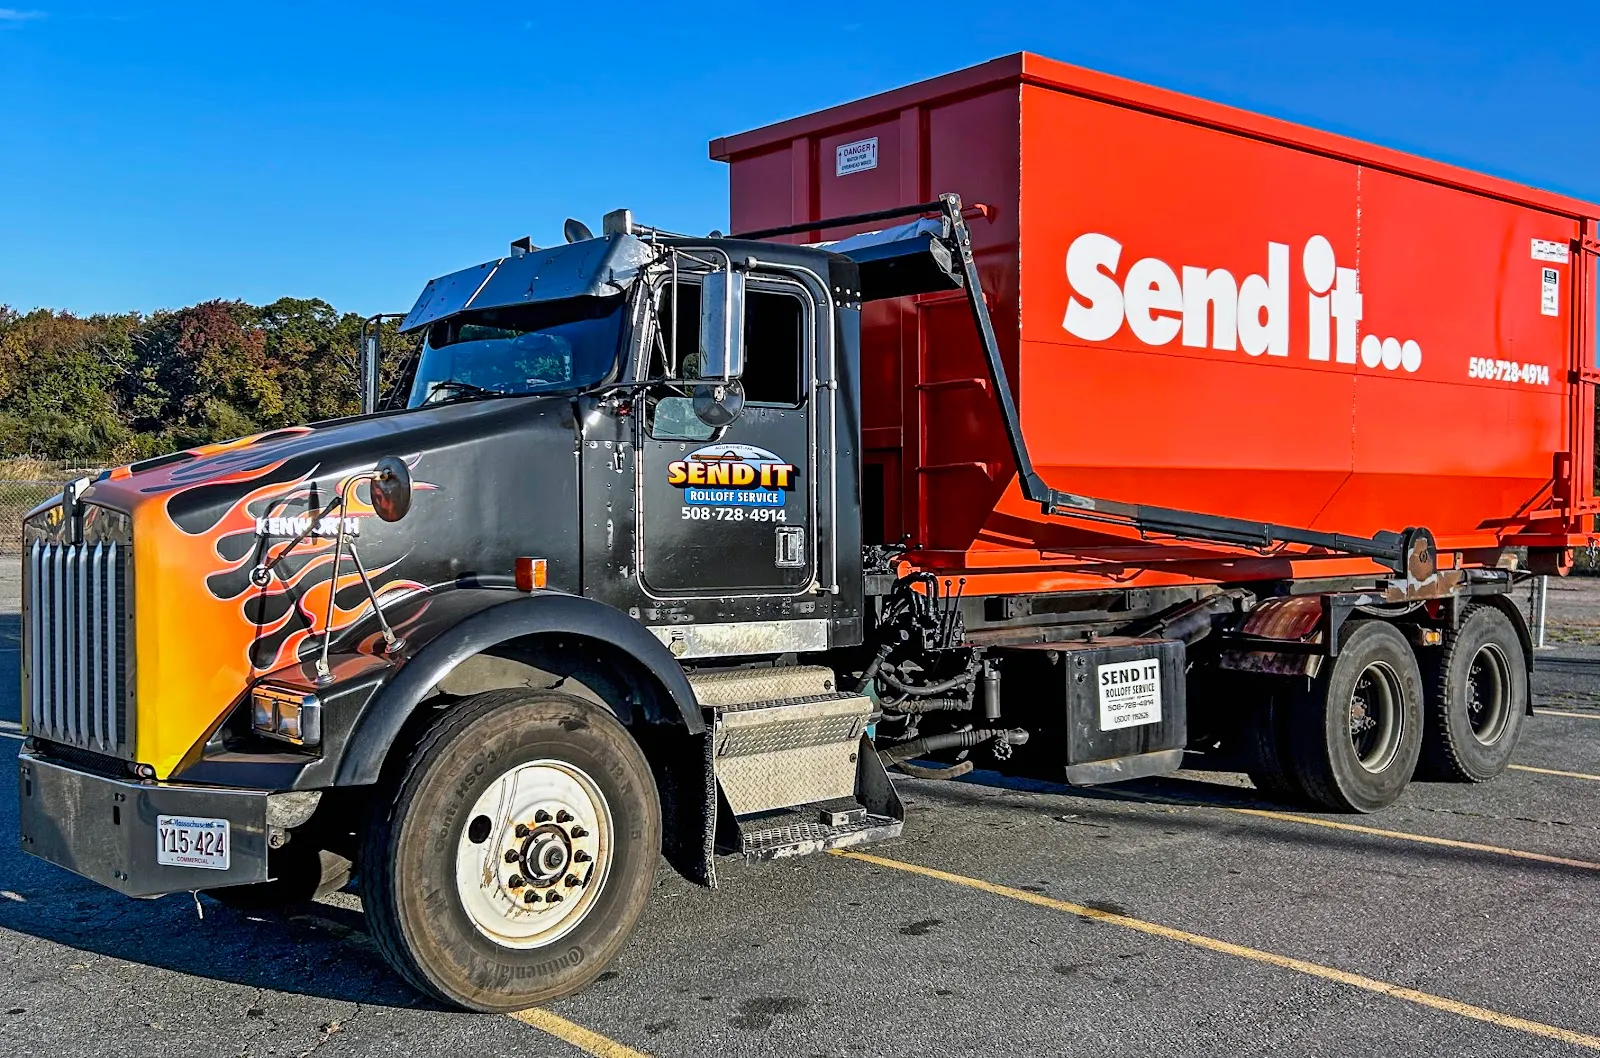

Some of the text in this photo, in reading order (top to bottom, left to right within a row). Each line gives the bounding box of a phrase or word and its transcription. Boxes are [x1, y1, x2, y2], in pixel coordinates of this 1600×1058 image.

[843, 143, 871, 156] DANGER
[1062, 233, 1290, 356] Send
[667, 460, 794, 489] SEND IT
[690, 490, 778, 503] ROLLOFF SERVICE
[1101, 665, 1157, 686] SEND IT
[1105, 683, 1155, 698] ROLLOFF SERVICE
[1114, 714, 1130, 723] USDOT
[434, 751, 497, 853] Conti HSC 3
[177, 856, 209, 864] COMMERCIAL
[494, 945, 585, 979] Continental
